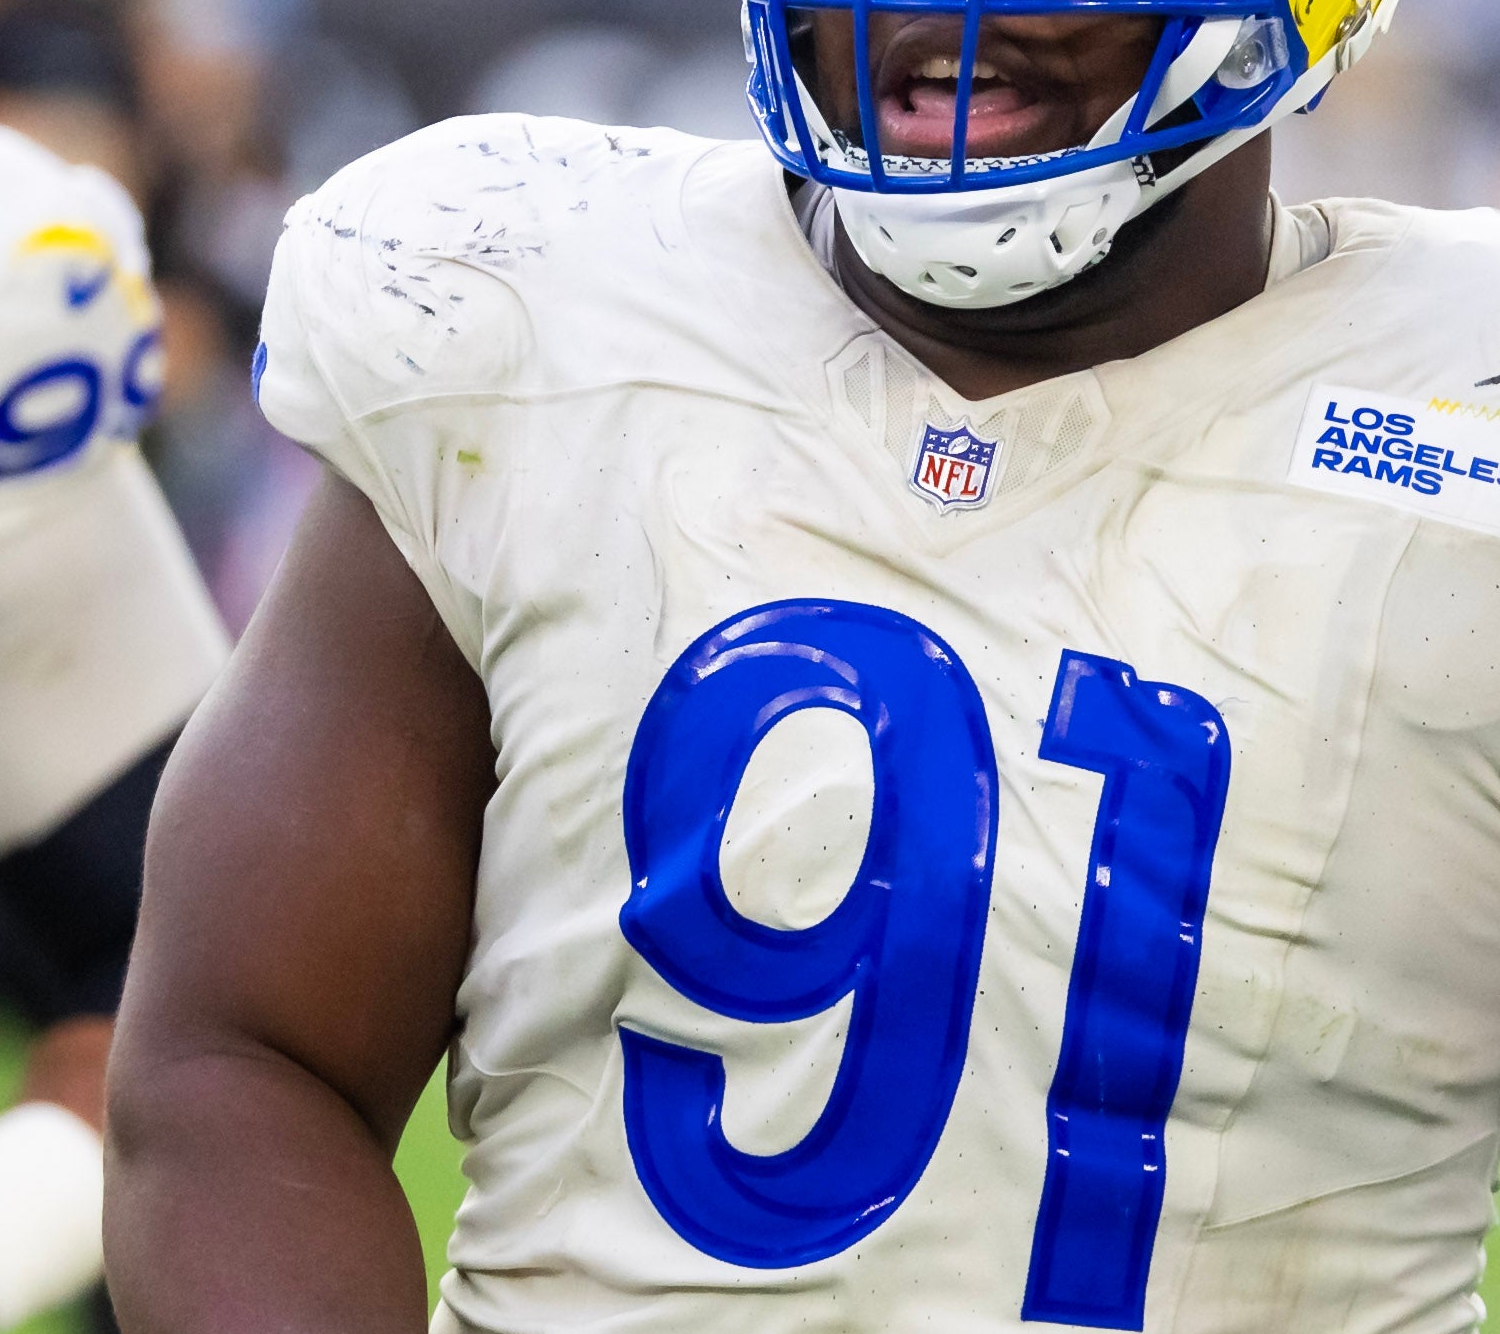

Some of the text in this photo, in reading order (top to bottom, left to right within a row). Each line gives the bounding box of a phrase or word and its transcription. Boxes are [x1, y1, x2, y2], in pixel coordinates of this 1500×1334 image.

[1323, 401, 1416, 436] LOS
[921, 454, 979, 497] NFL
[1311, 448, 1444, 496] RAMS
[618, 597, 1233, 1333] 91
